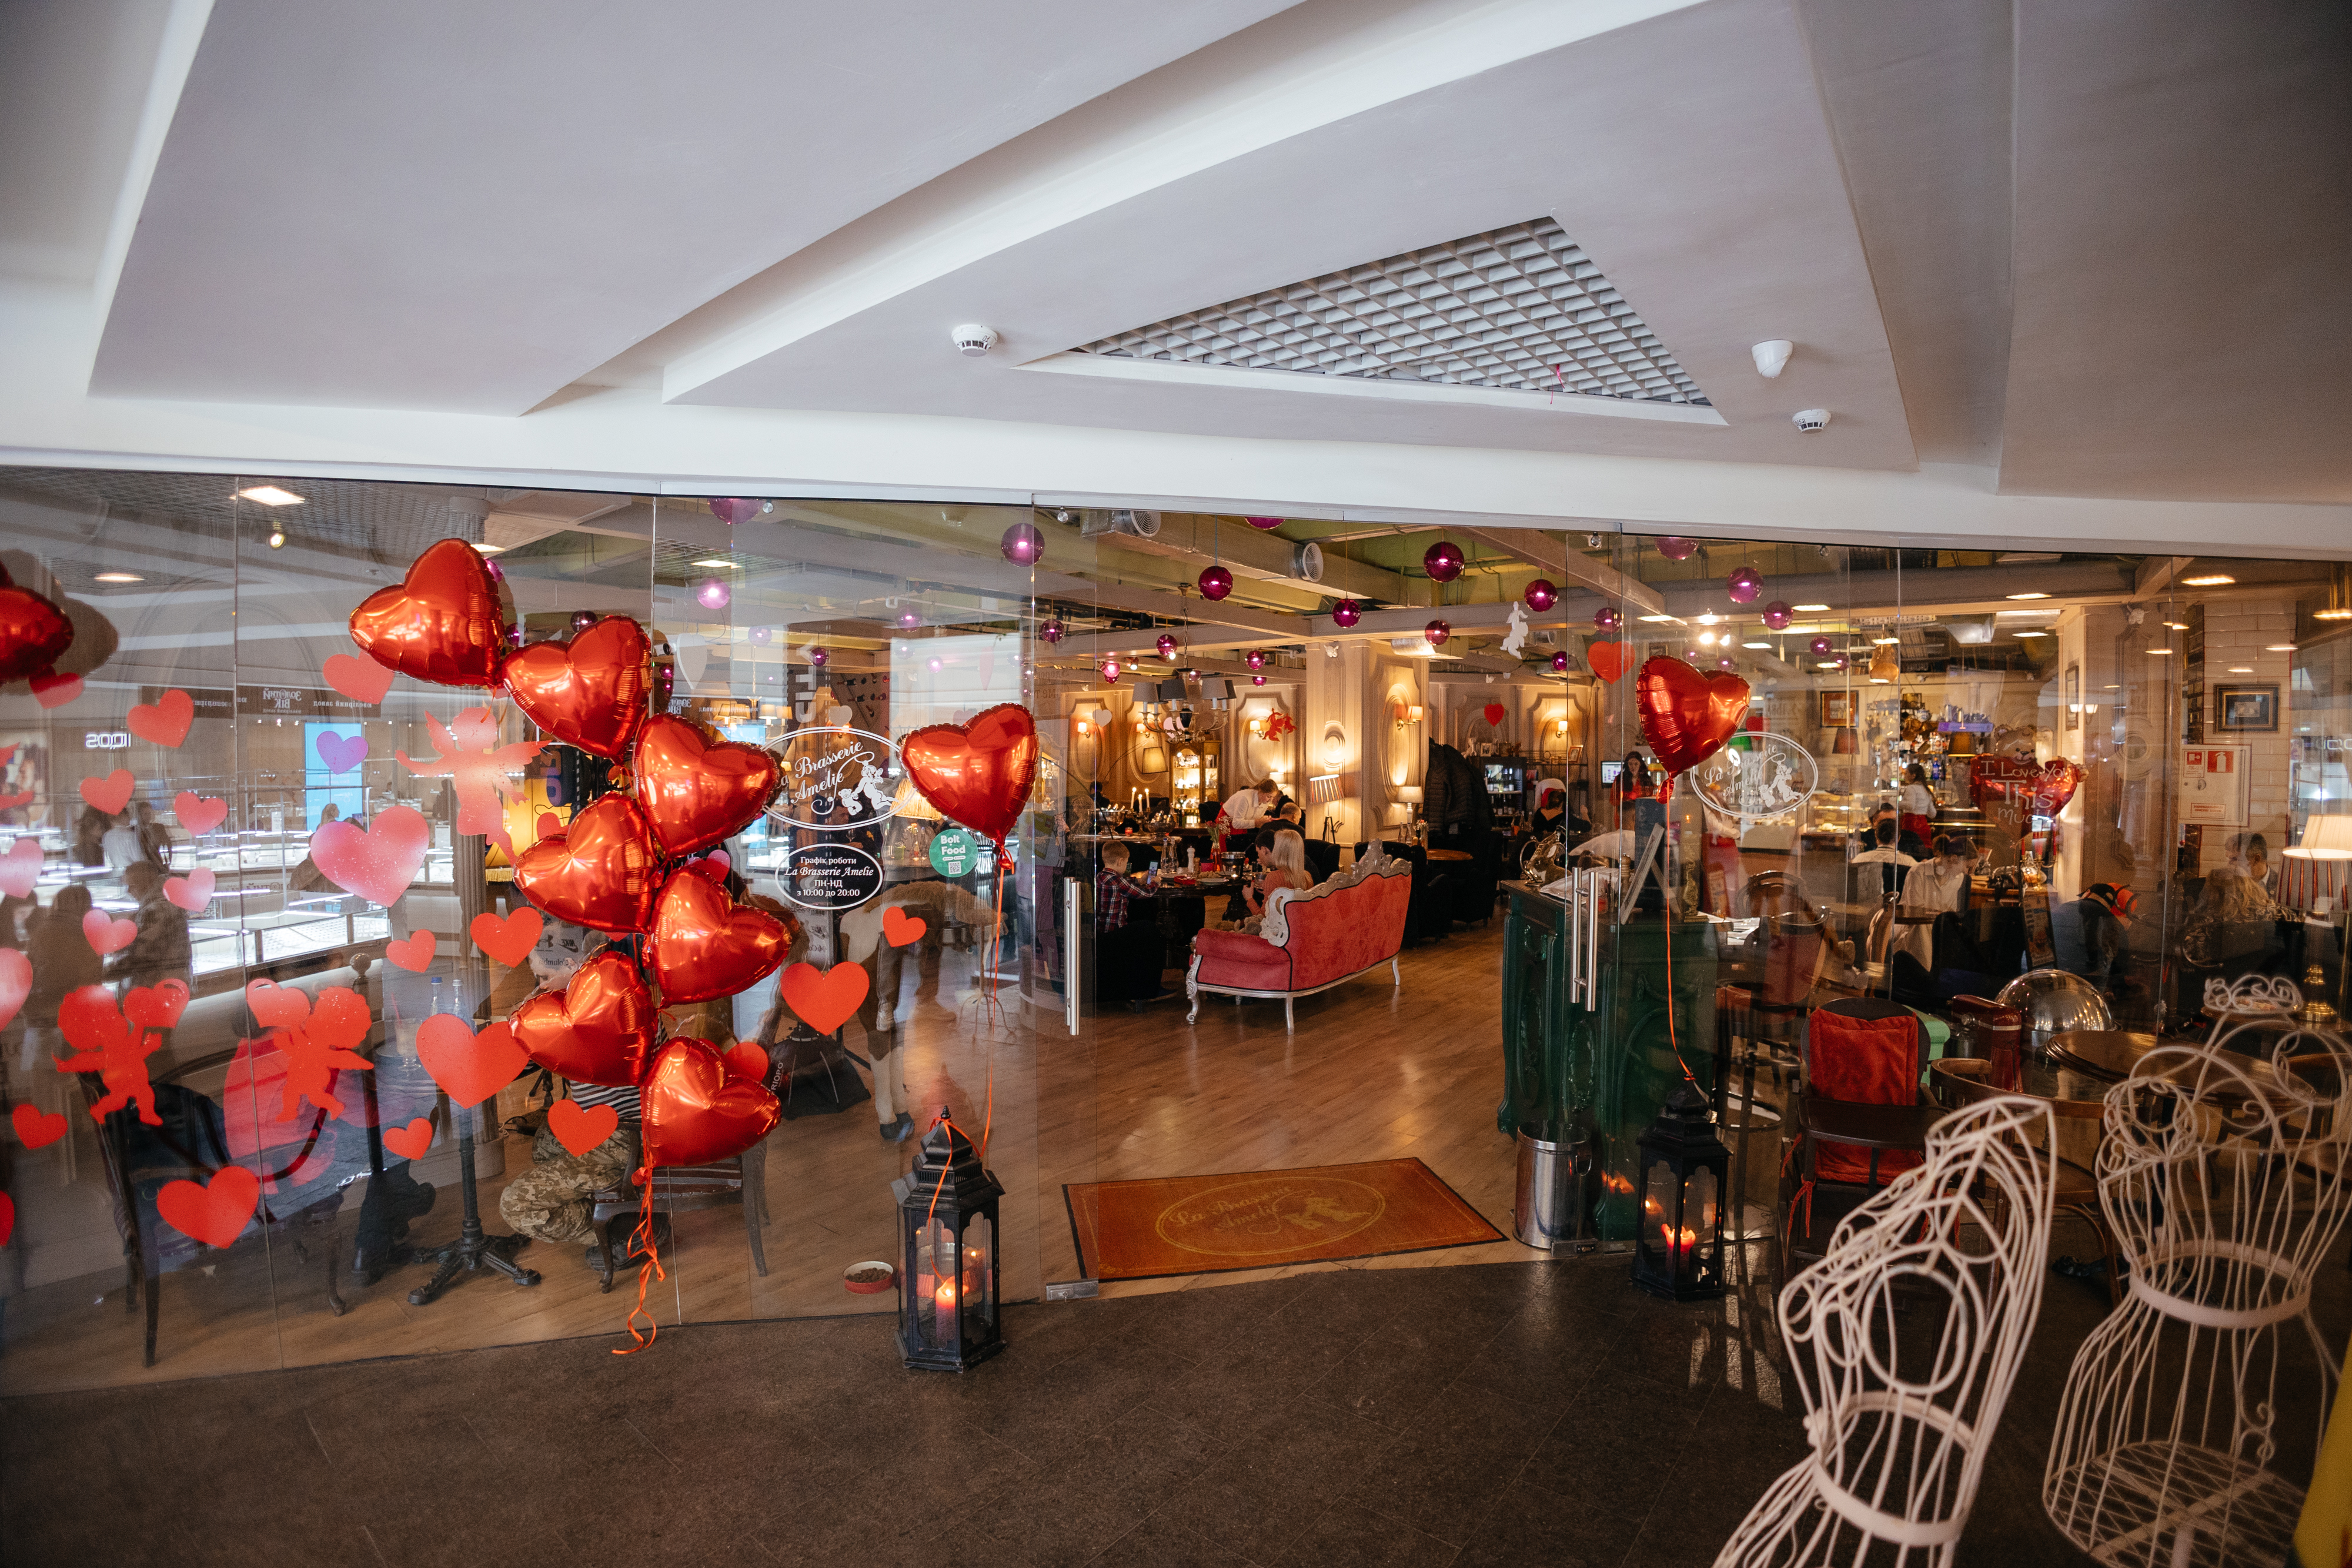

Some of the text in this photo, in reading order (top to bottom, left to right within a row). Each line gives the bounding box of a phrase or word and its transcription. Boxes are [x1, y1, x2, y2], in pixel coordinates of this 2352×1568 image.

[795, 741, 863, 778] Brasserie
[1704, 766, 1723, 787] La
[1980, 760, 1995, 775] I
[2001, 761, 2039, 778] Love
[790, 770, 844, 804] Amelie
[1992, 779, 2054, 810] This
[940, 835, 960, 846] Bolt
[941, 845, 965, 855] Food
[800, 857, 857, 865] Графік роботи
[784, 866, 874, 877] La Brasserie Amelie
[814, 880, 843, 888] ПН-НД
[771, 1062, 783, 1091] RIOPO
